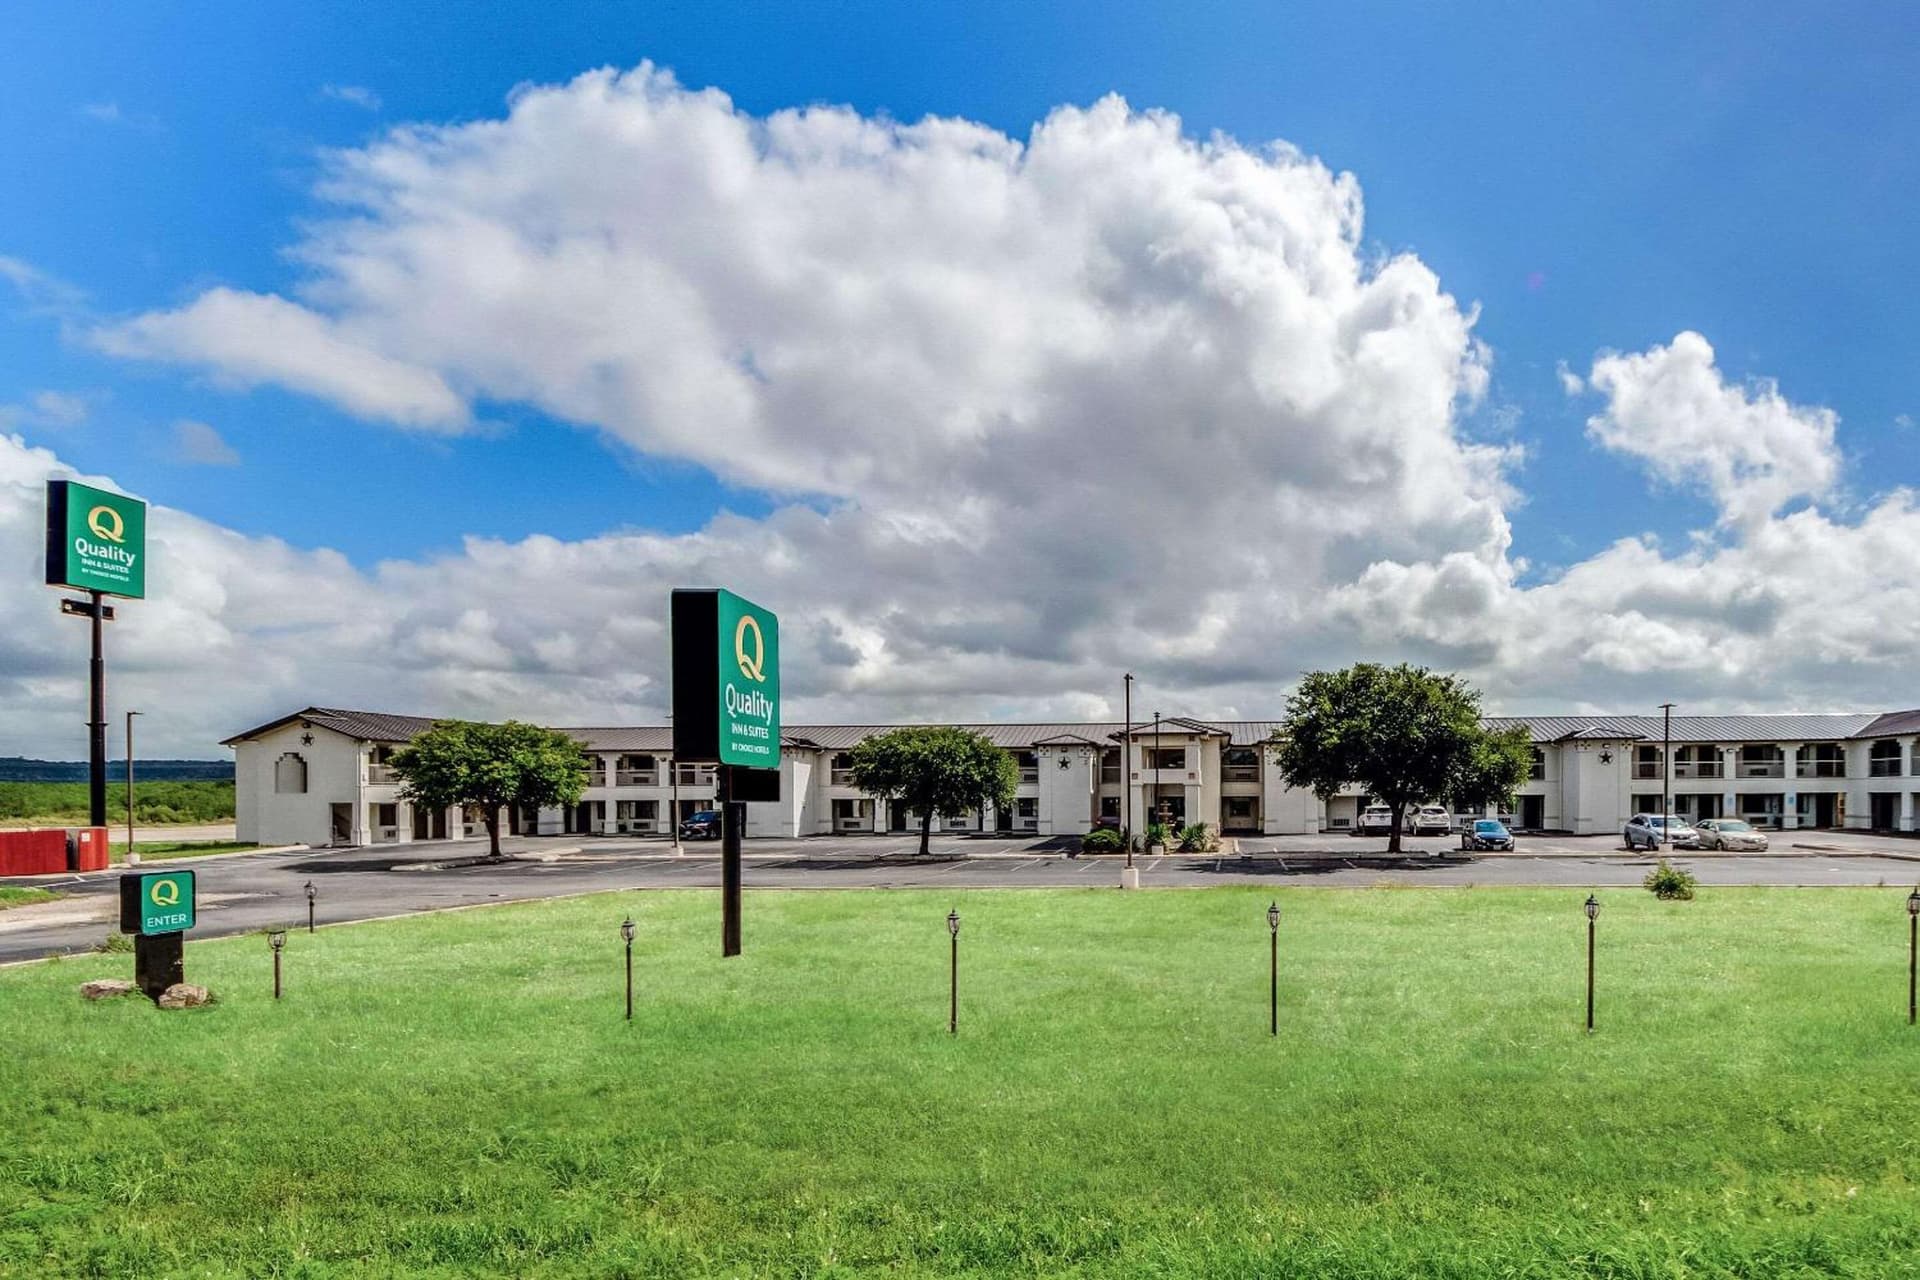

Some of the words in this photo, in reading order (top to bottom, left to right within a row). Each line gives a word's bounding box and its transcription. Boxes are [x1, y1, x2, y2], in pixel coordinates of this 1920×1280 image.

[88, 506, 126, 543] Q
[75, 537, 136, 567] Quality
[735, 615, 766, 683] Q
[725, 683, 773, 726] Quality
[731, 723, 743, 736] INN
[748, 725, 769, 739] SUITES
[151, 879, 182, 907] Q
[146, 913, 187, 927] ENTER
